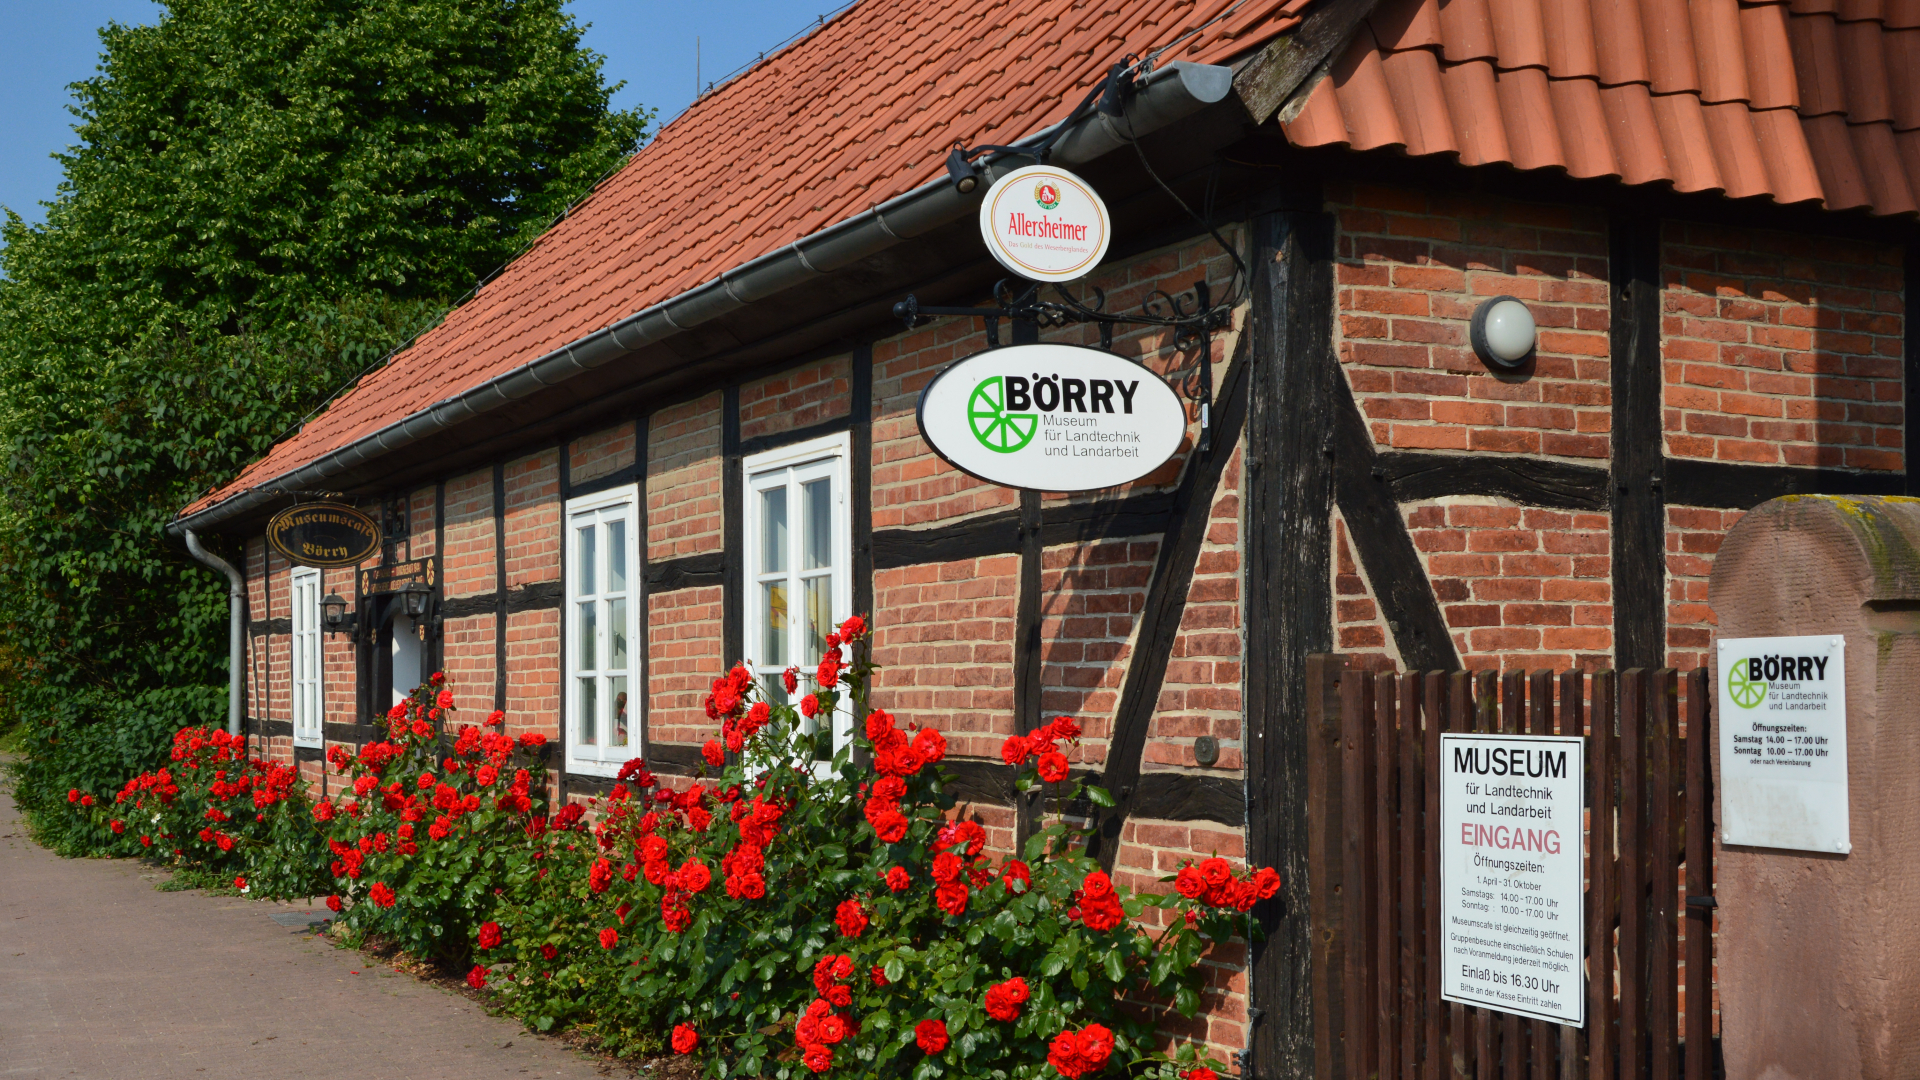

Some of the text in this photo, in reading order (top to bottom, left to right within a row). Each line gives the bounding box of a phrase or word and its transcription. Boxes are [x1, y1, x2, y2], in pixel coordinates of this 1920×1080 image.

[1008, 213, 1087, 241] Allersheimer
[1045, 244, 1089, 253] Weserberglandes
[1005, 373, 1140, 414] BÖRRY
[1043, 414, 1097, 427] Museum
[1045, 429, 1141, 442] für Landtechnik
[1045, 445, 1139, 457] und Landarbeit
[303, 542, 348, 558] Börry
[1749, 654, 1829, 681] BÖRRY
[1769, 682, 1801, 690] Museum
[1769, 692, 1828, 700] für Landtechnik
[1769, 702, 1827, 710] und Landarbeit
[1752, 722, 1807, 734] Öffnungszeiten:
[1734, 735, 1763, 745] Samstag
[1766, 736, 1785, 744] 14.00
[1794, 736, 1813, 744] 17.00
[1815, 737, 1829, 745] Uhr
[1734, 746, 1762, 756] Sonntag
[1795, 748, 1814, 756] 17.00
[1815, 749, 1829, 757] Uhr
[1455, 747, 1566, 779] MUSEUM
[1466, 783, 1553, 800] für Landtechnik
[1467, 802, 1552, 819] und Landarbeit
[1462, 823, 1560, 854] EINGANG
[1474, 852, 1545, 874] Öffnungszeiten:
[1477, 876, 1481, 884] 1.
[1483, 876, 1498, 886] April
[1504, 879, 1512, 888] 31.
[1514, 880, 1541, 891] Oktober
[1462, 887, 1495, 900] Samstags:
[1501, 893, 1519, 903] 14.00
[1525, 896, 1544, 906] 17.00
[1547, 898, 1559, 908] Uhr
[1501, 905, 1519, 915] 10.00
[1525, 909, 1544, 919] 17.00
[1547, 911, 1559, 921] Uhr
[1503, 923, 1539, 938] gleichzeitig
[1540, 930, 1570, 942] geöffnet.
[1451, 933, 1574, 960] Gruppenbesuche einschließlich Schulen
[1454, 946, 1570, 972] nach Voranmeldung jederzeit möglich.
[1462, 965, 1560, 994] Einlaß bis 16.30 Uhr
[1460, 983, 1562, 1010] Bitte an der Kasse Eintritt zahlen
